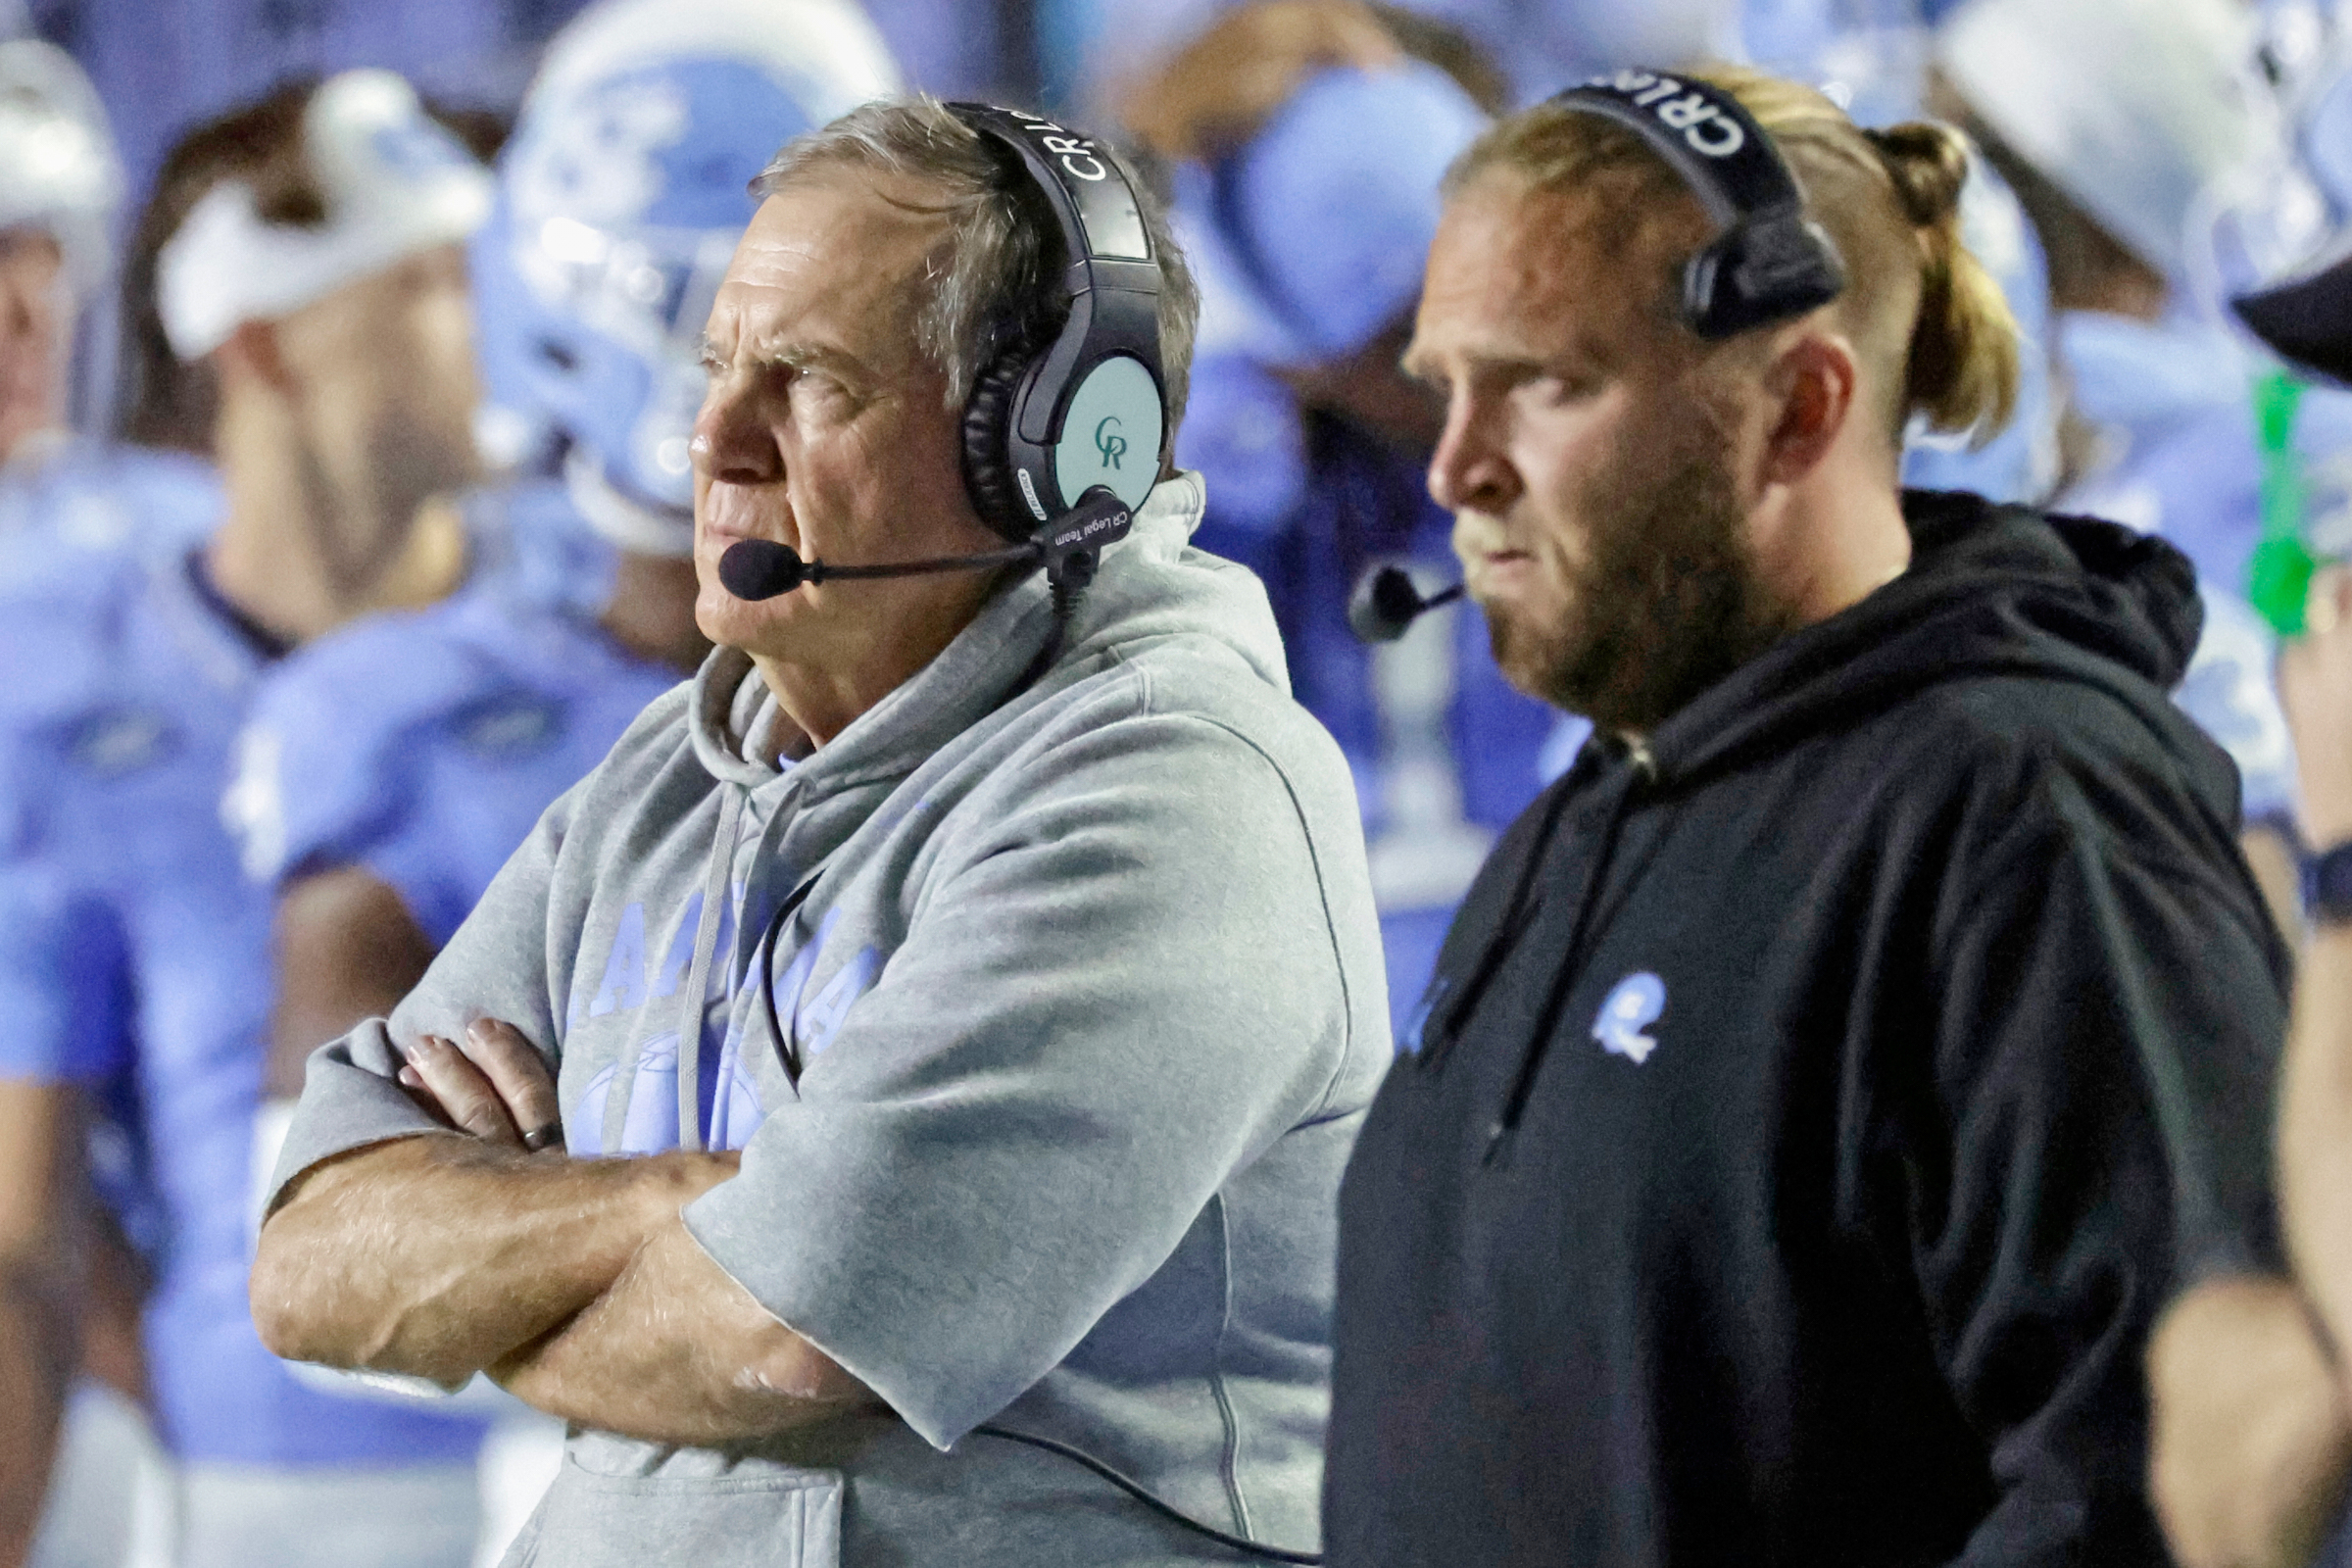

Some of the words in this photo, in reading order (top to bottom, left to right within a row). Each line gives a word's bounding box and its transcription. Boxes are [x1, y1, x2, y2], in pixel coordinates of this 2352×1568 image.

[1657, 93, 1744, 158] CR
[1042, 135, 1107, 181] CR
[1095, 416, 1128, 471] CR
[1083, 516, 1113, 536] Legal
[1113, 510, 1129, 527] CR
[1054, 528, 1084, 547] Team
